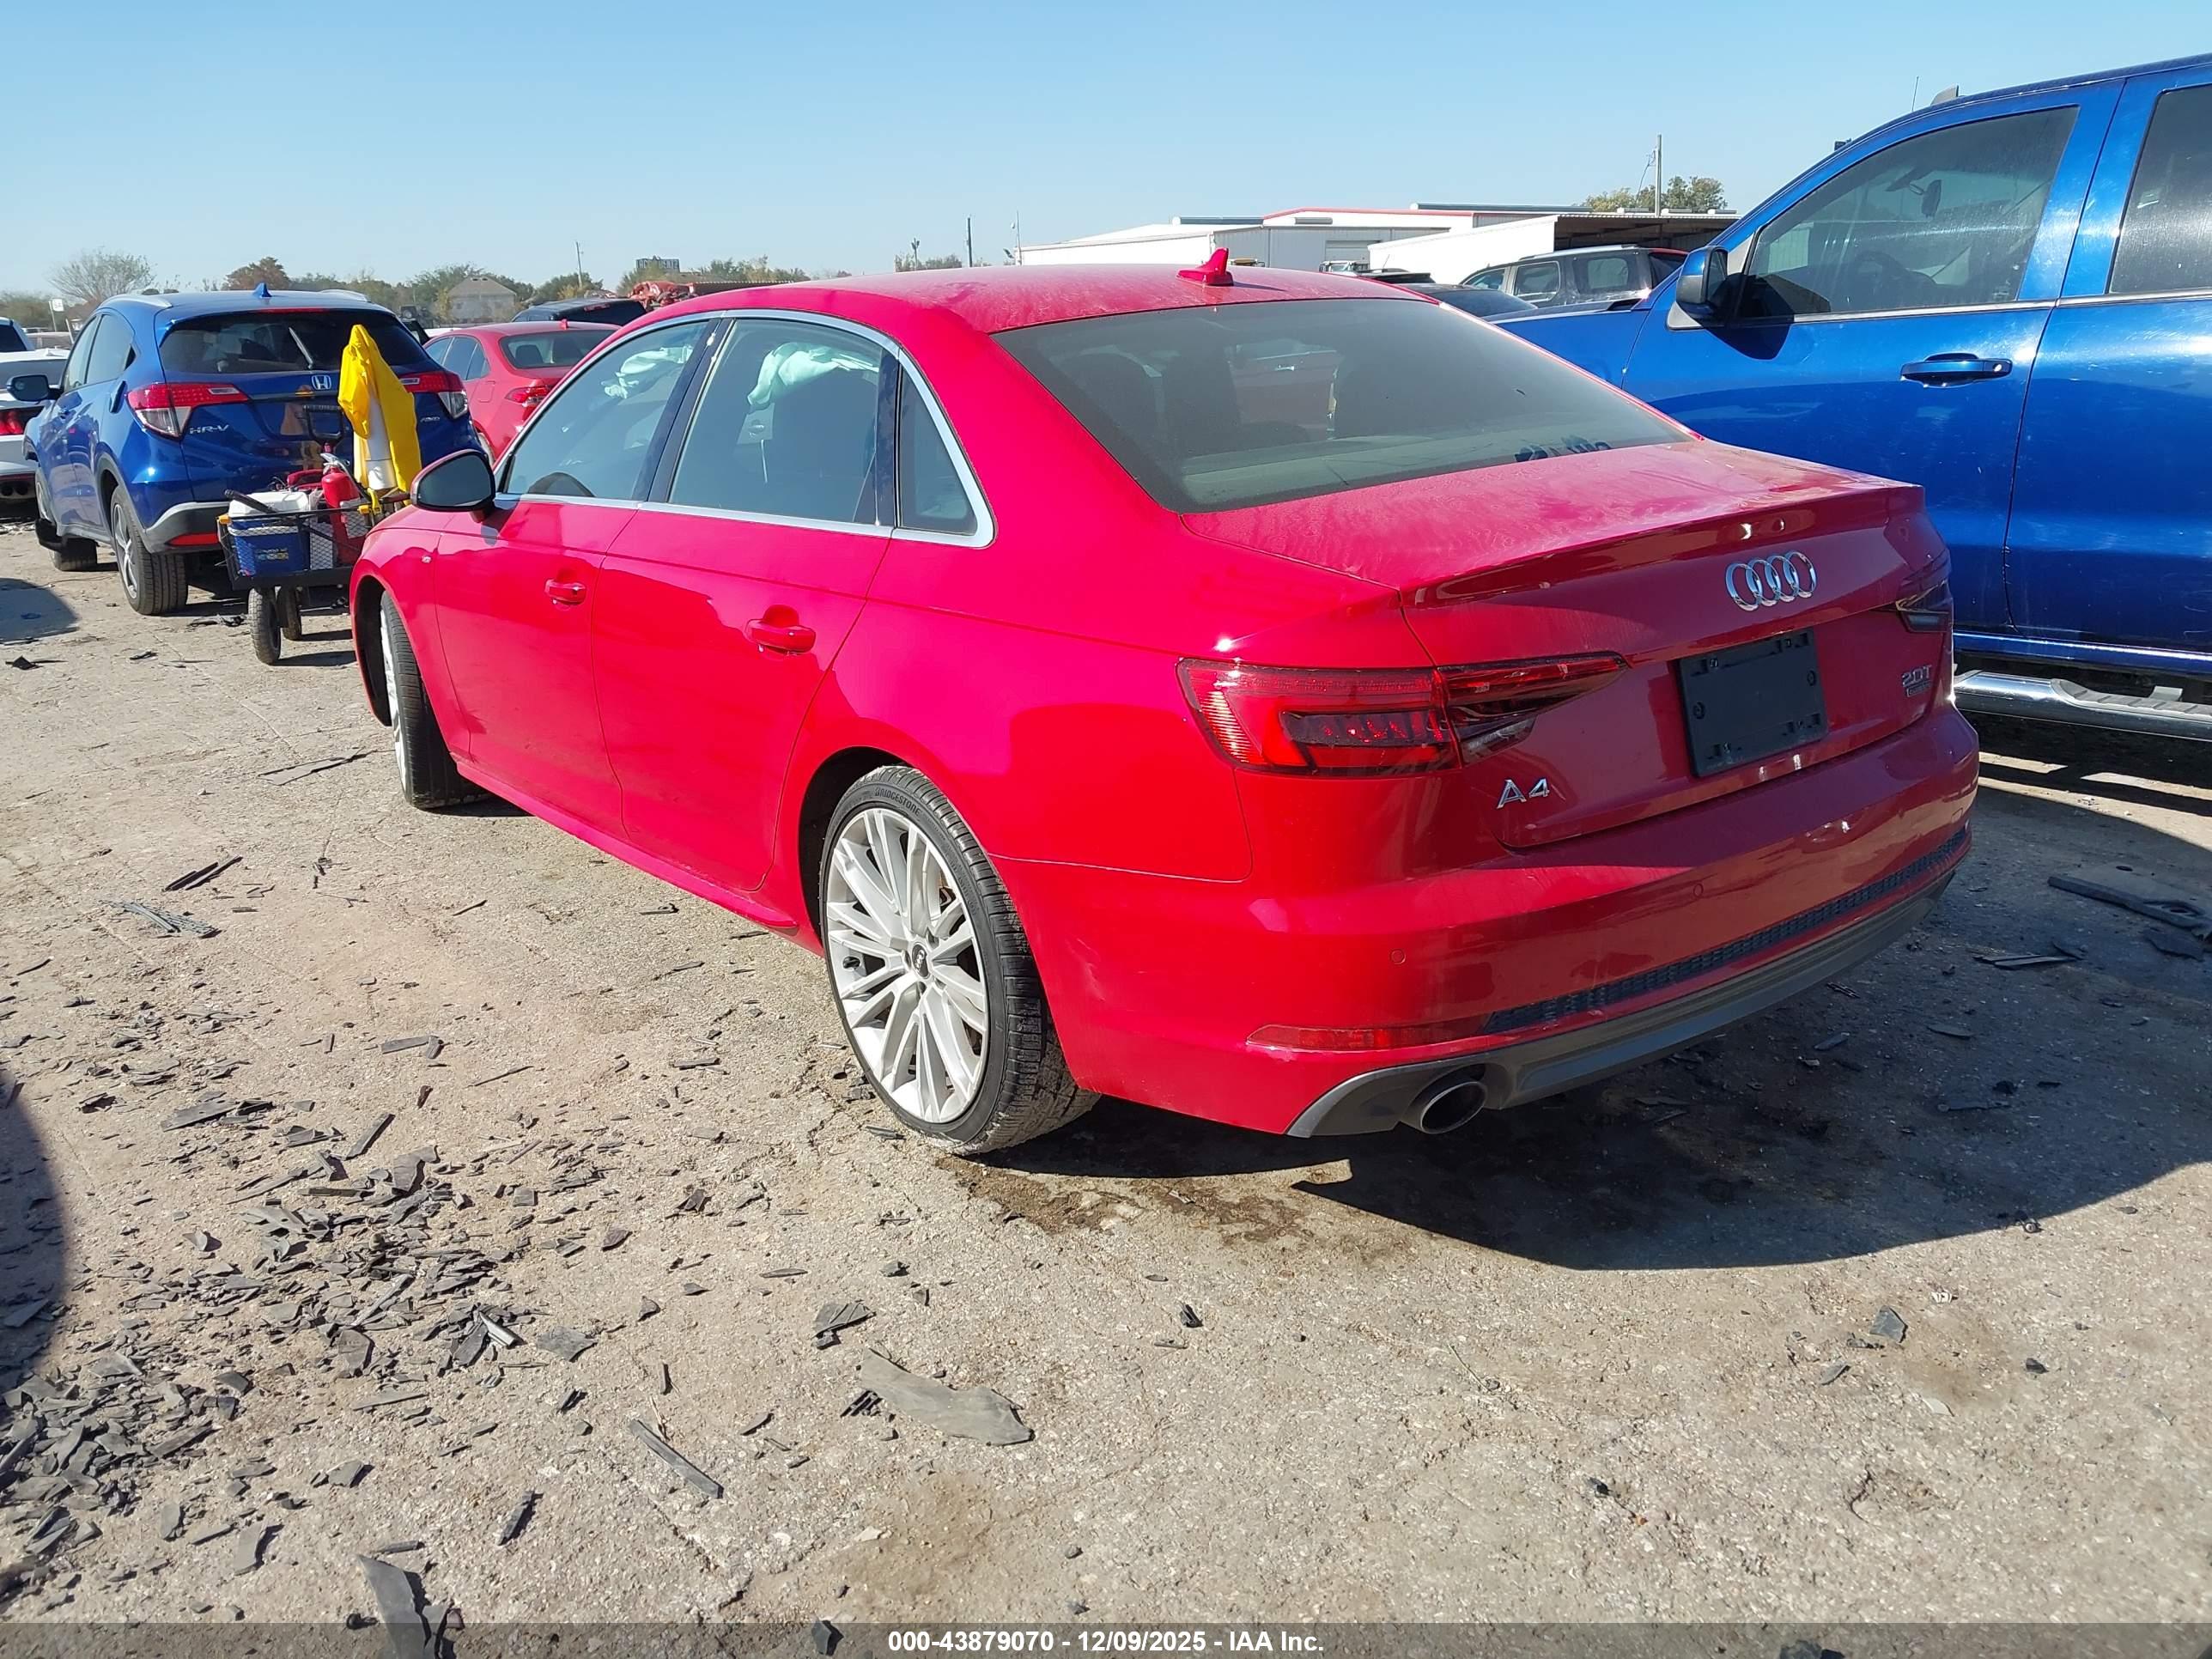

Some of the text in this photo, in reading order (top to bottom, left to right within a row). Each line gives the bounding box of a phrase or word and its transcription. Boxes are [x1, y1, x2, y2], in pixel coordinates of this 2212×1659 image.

[189, 424, 229, 434] HR-V
[875, 787, 921, 817] BRIDGESTONE
[1497, 778, 1550, 809] A4
